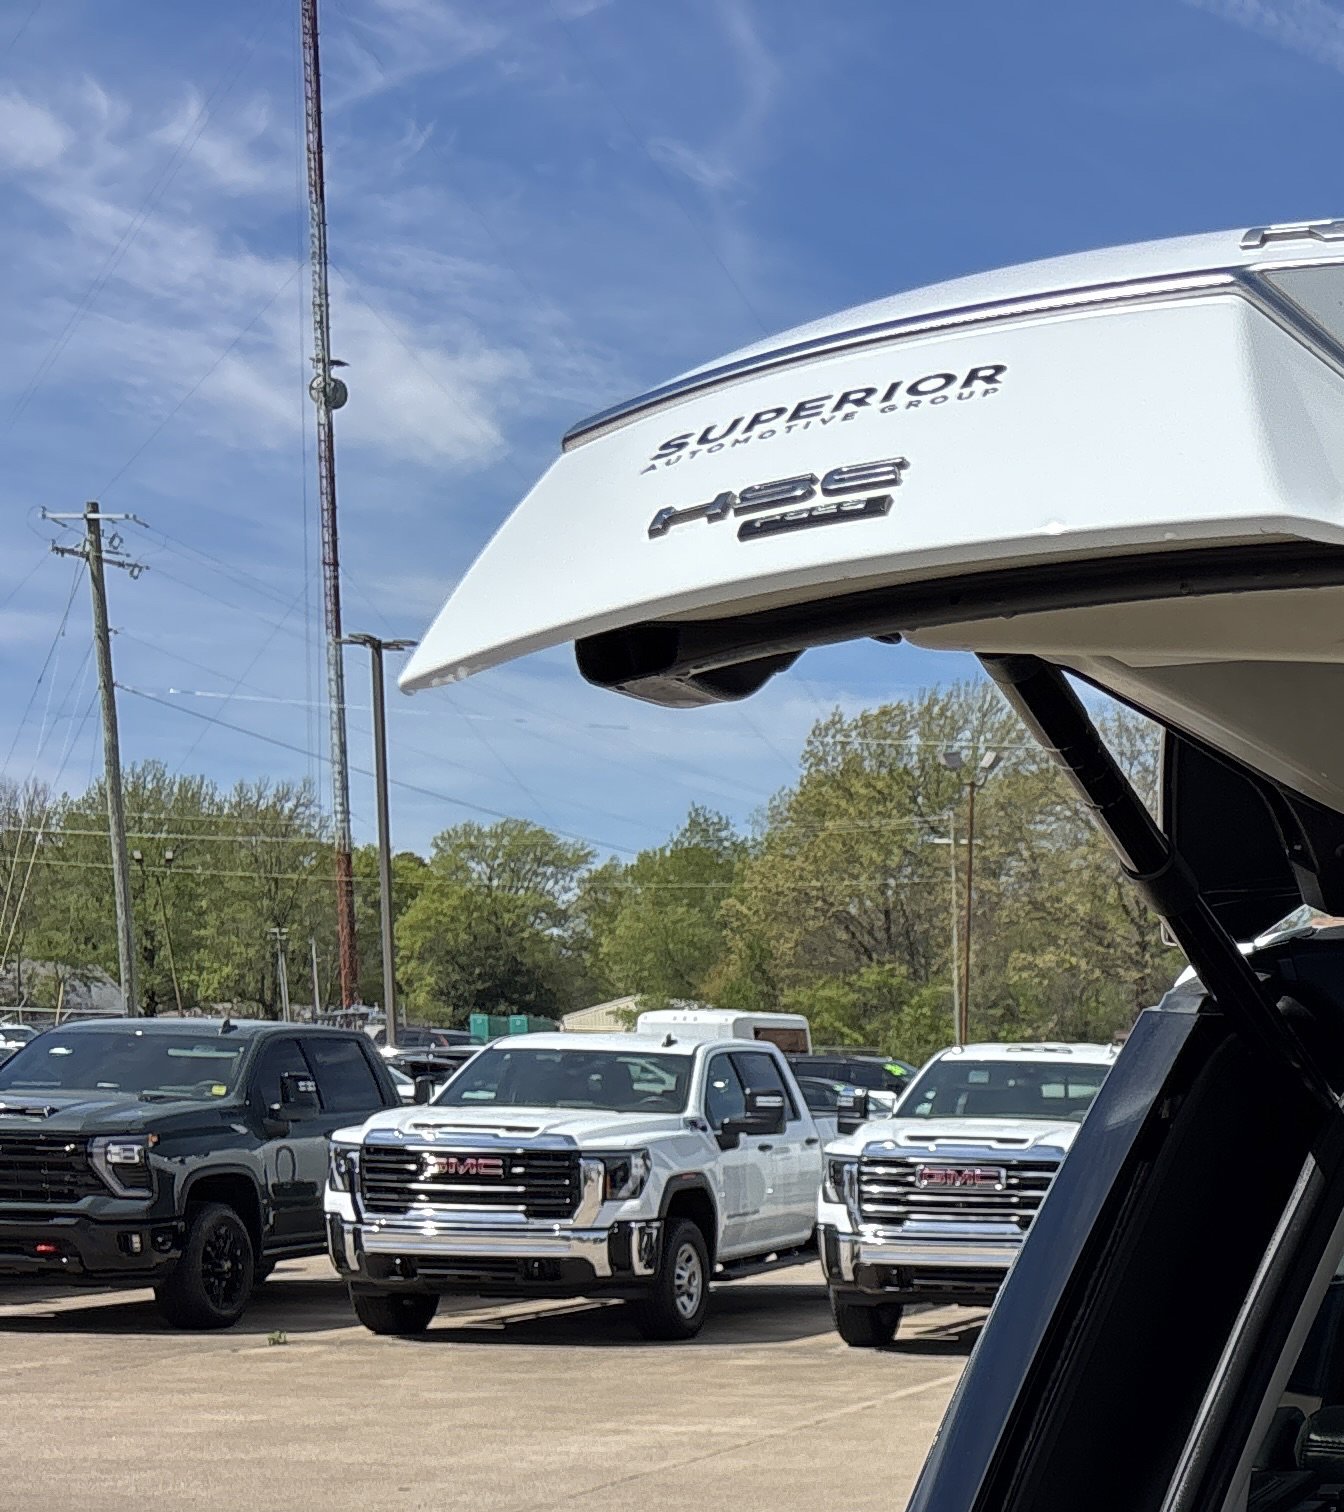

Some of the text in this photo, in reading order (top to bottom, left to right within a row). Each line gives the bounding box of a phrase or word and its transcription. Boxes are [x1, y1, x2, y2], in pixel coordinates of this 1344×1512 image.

[640, 387, 1002, 476] AUTOMOTIVE GROUP
[651, 364, 1009, 462] SUPERIOR
[424, 1156, 504, 1177] GMC
[921, 1168, 1000, 1185] GMC
